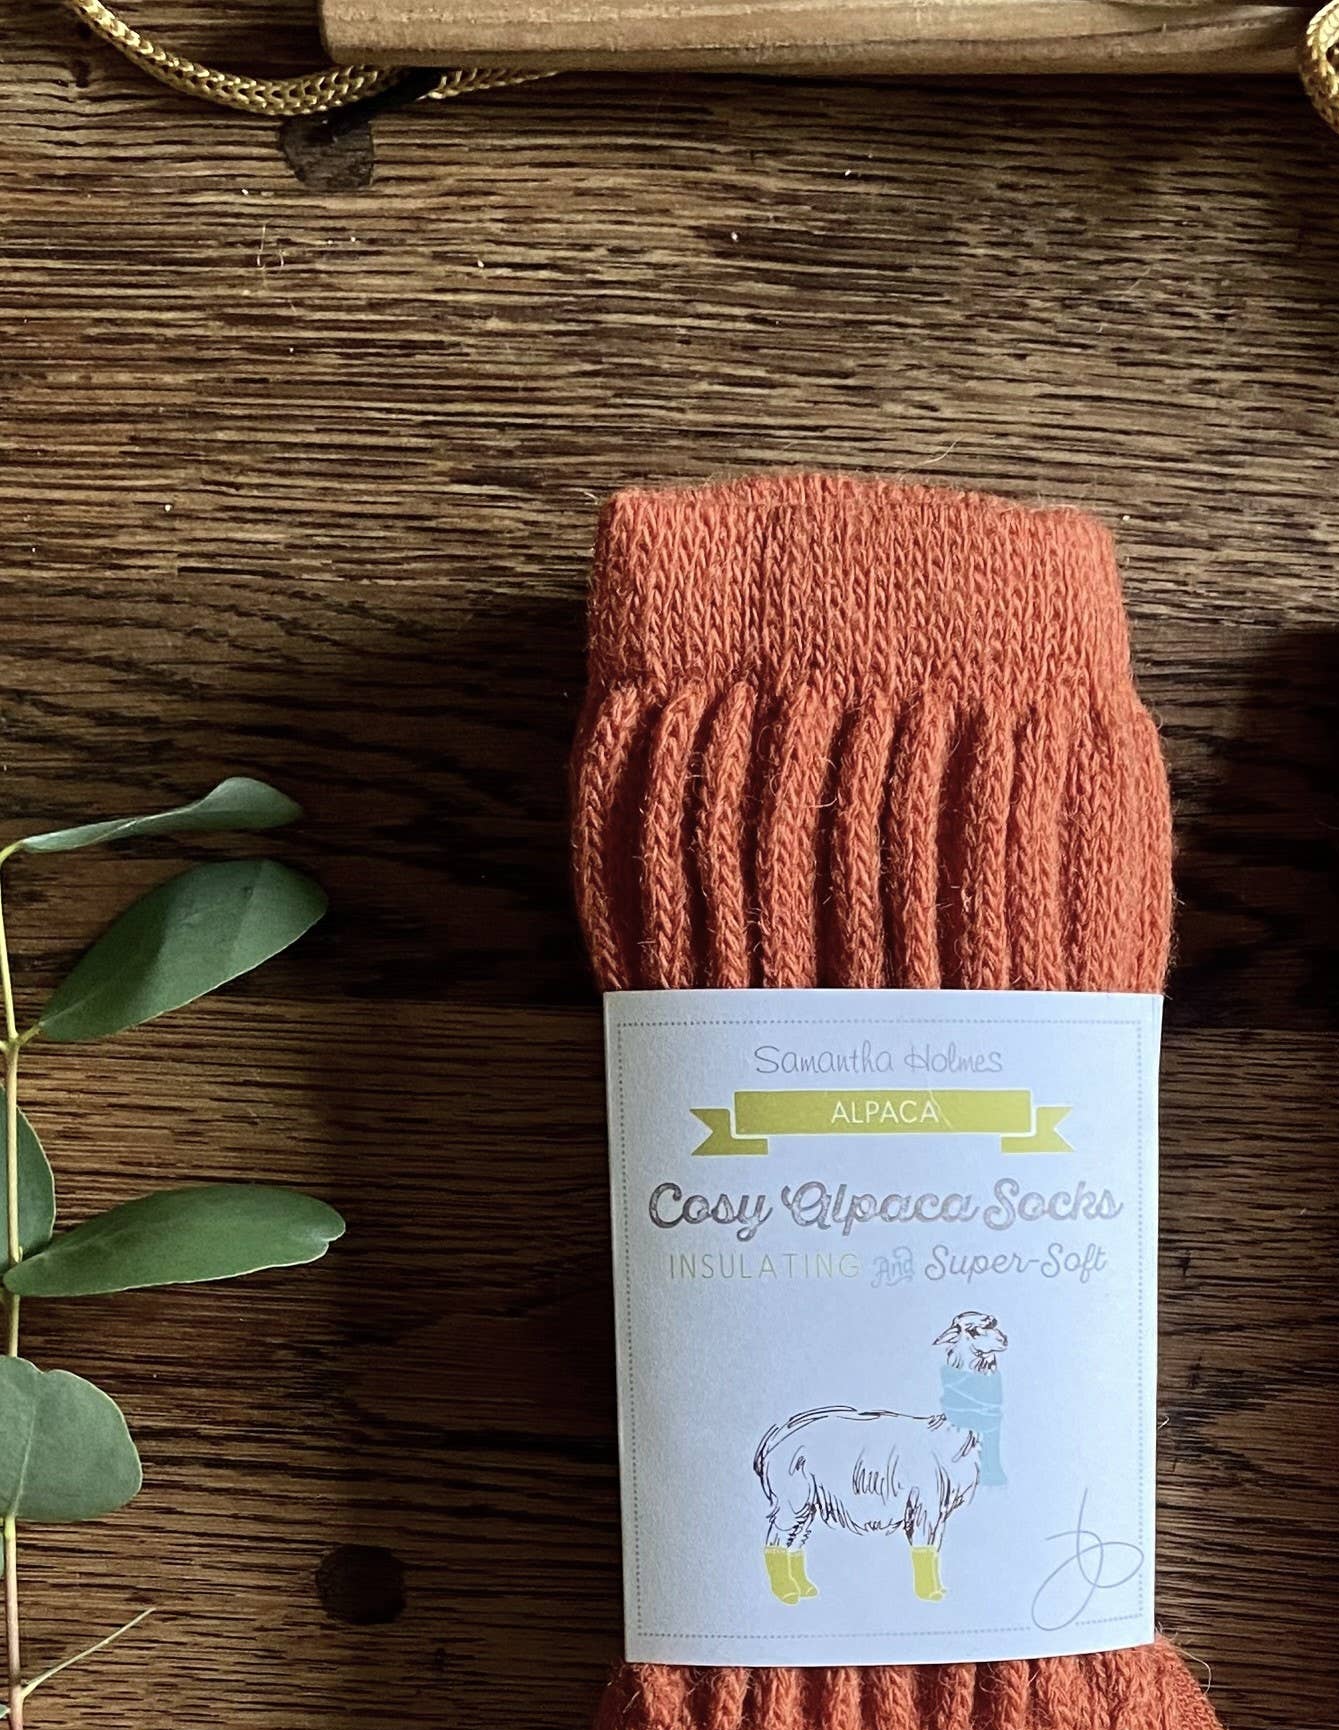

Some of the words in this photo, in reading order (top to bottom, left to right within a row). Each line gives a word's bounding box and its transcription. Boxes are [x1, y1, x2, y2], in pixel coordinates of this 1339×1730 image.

[753, 1039, 893, 1075] Samantha
[903, 1041, 1004, 1075] Holmes
[831, 1100, 941, 1124] ALPACA
[647, 1181, 773, 1242] Cosy
[781, 1180, 981, 1236] Alpaca
[982, 1178, 1124, 1232] Socks
[669, 1251, 861, 1280] INSULATING
[924, 1241, 1108, 1289] Super-Soft
